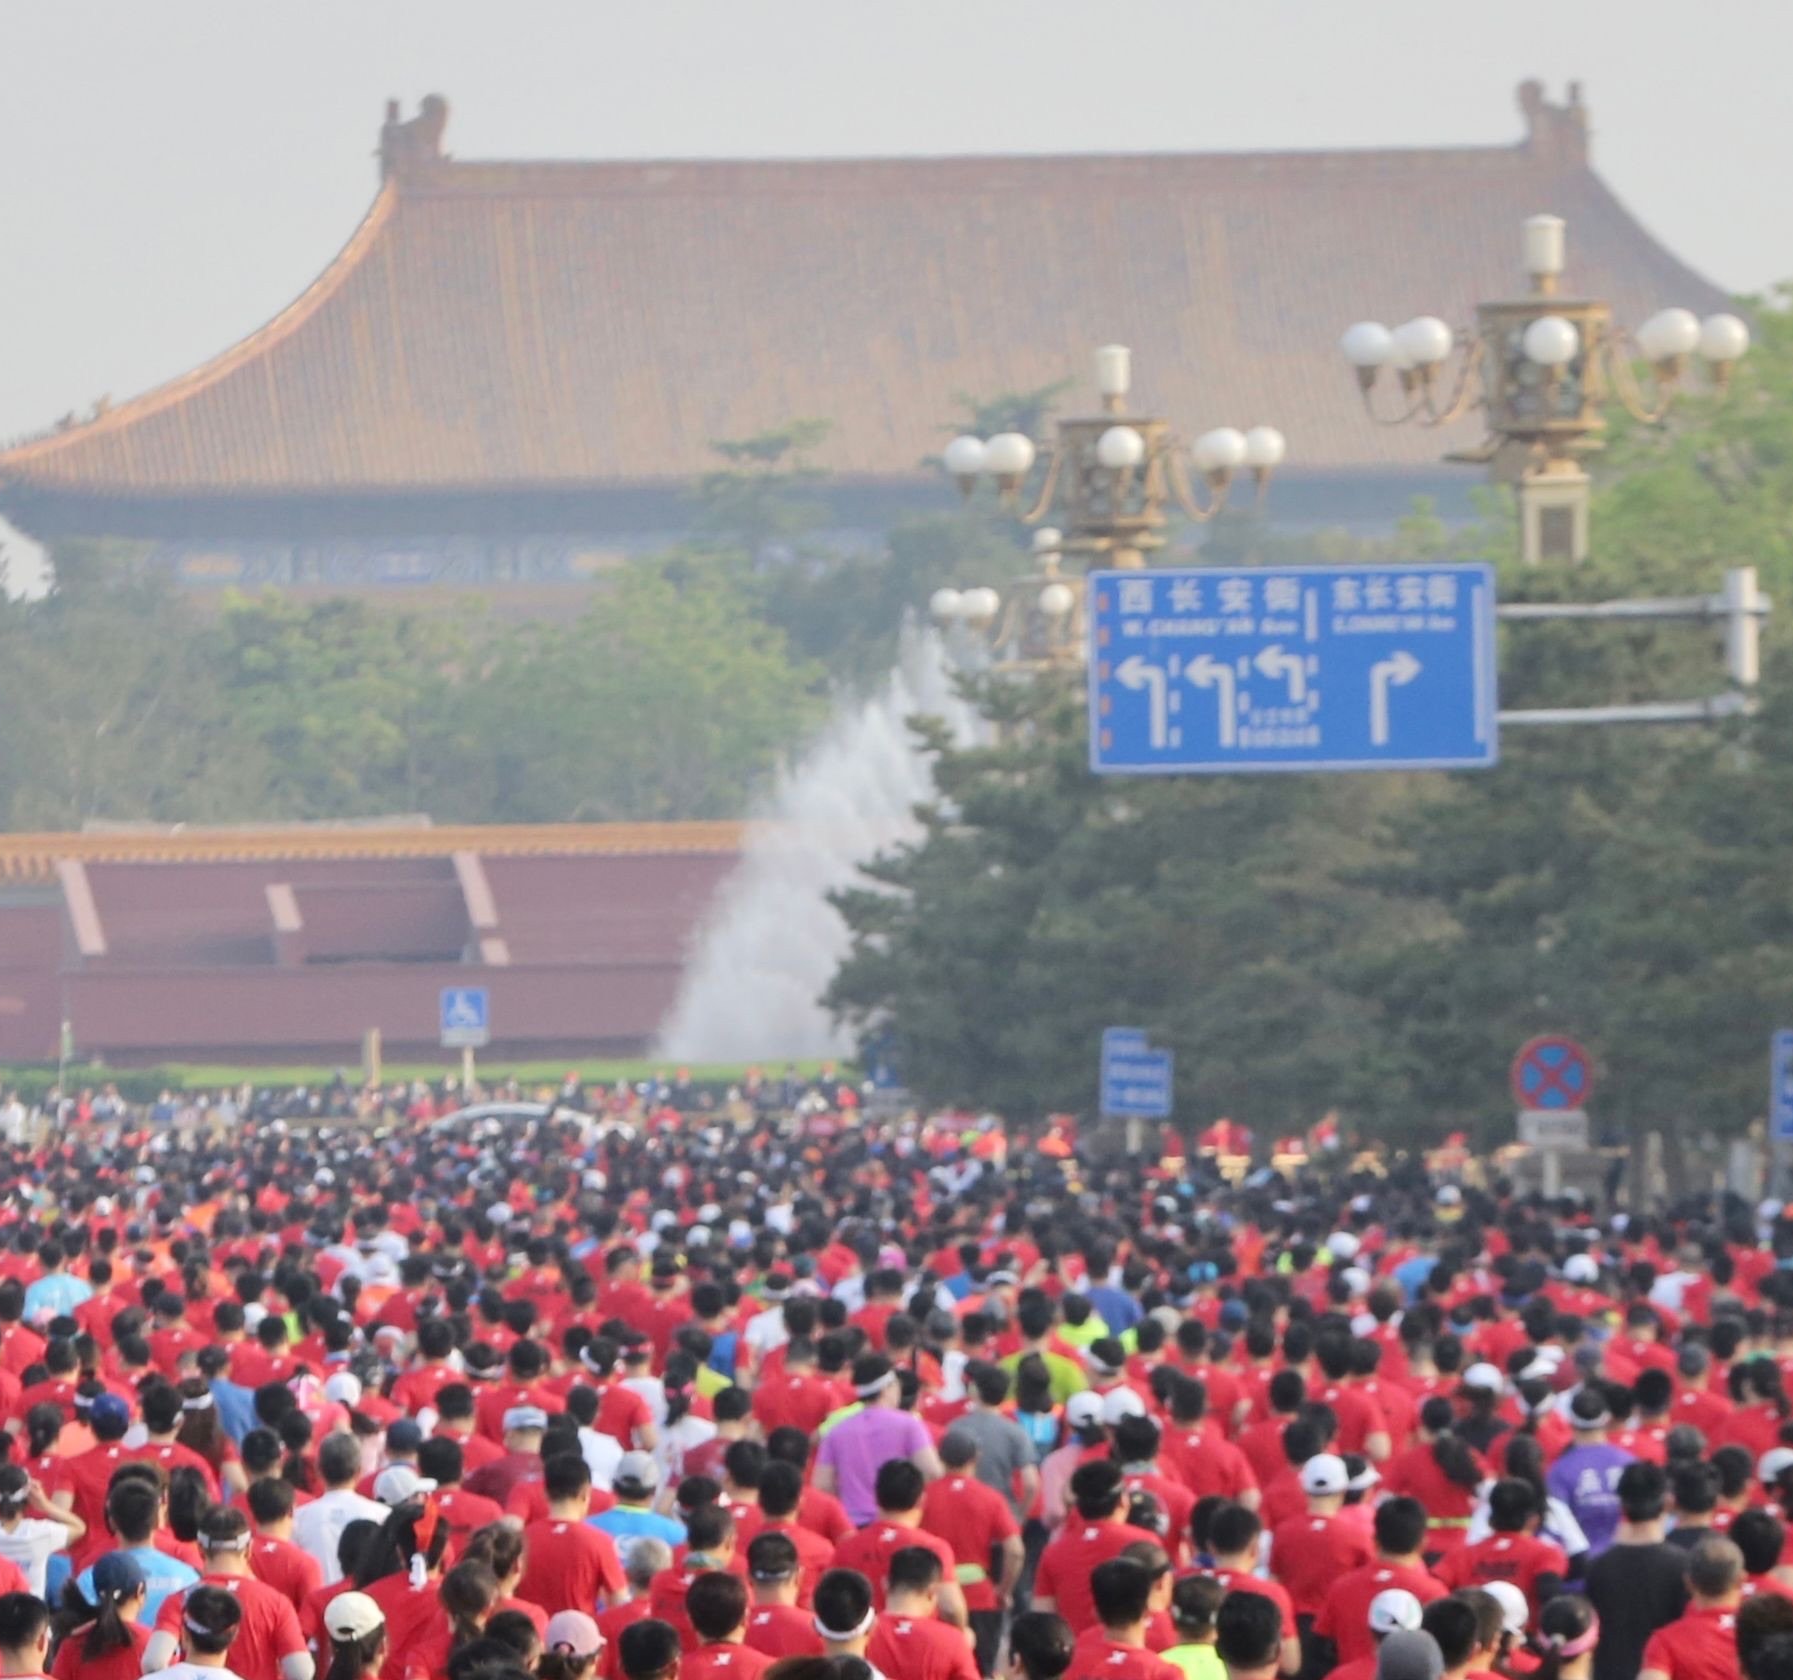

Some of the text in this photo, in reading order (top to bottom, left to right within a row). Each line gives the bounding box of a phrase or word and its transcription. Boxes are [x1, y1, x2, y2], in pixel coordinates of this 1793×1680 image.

[1117, 577, 1301, 614] 西长安街
[1330, 574, 1457, 610] 东长安街
